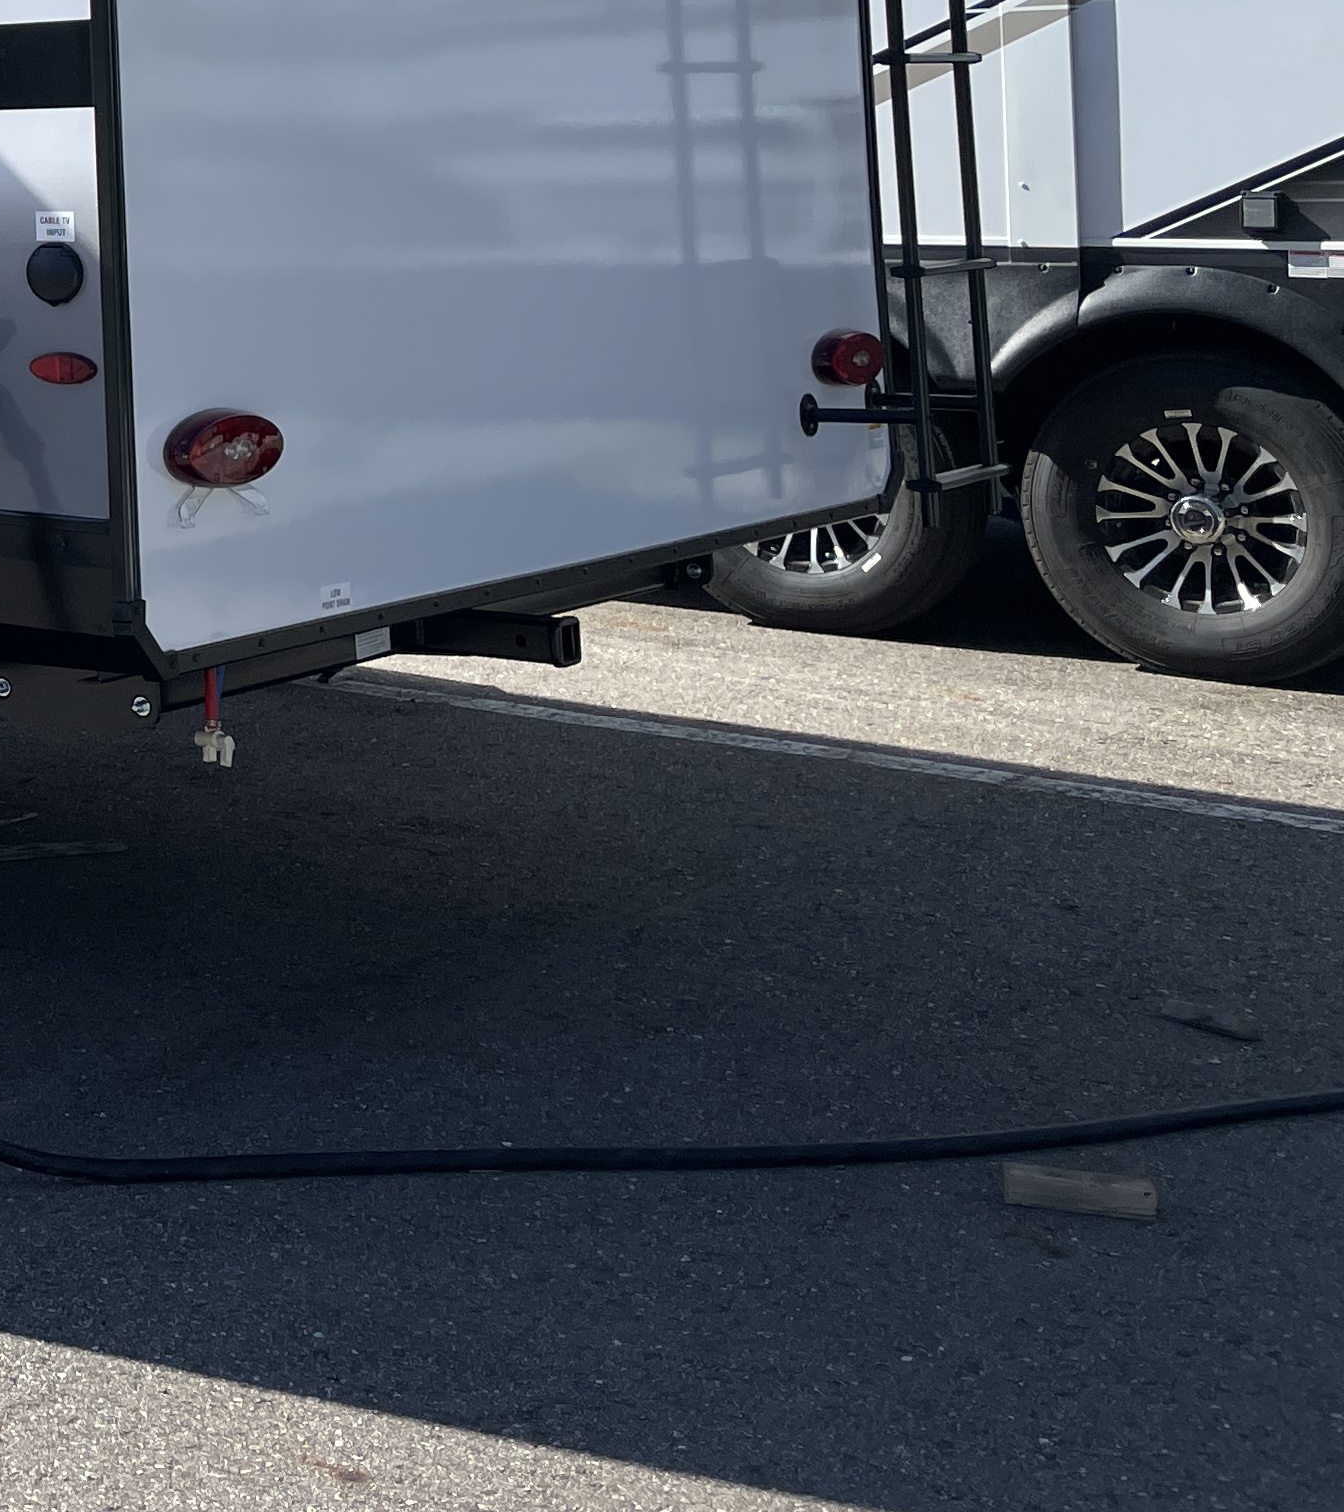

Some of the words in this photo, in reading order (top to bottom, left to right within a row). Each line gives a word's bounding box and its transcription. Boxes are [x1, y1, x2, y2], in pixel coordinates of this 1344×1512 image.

[39, 216, 60, 225] CABLE
[61, 216, 71, 225] TV
[46, 228, 66, 237] INPUT
